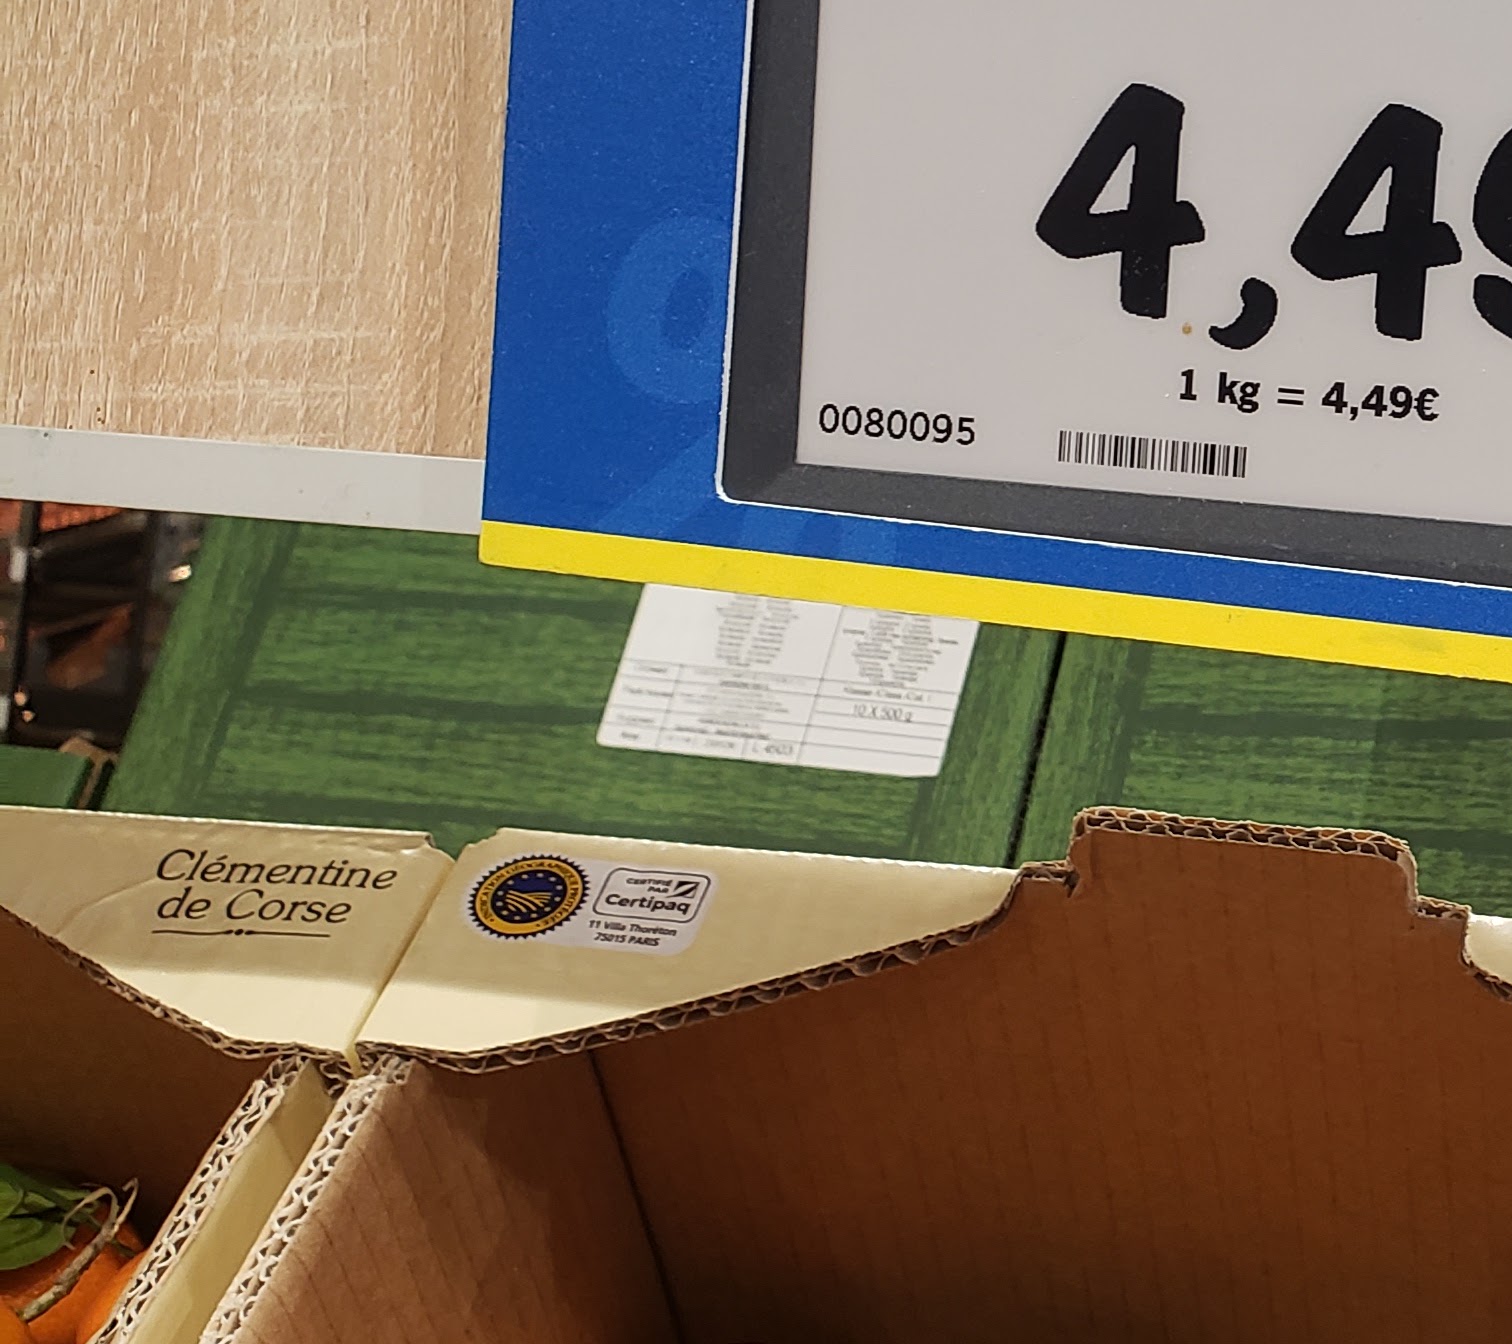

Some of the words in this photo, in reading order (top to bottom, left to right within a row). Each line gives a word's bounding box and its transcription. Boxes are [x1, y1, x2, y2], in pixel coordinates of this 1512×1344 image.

[1178, 368, 1198, 401] 1
[1217, 372, 1260, 413] kg
[1277, 385, 1305, 408] =
[1321, 381, 1441, 422] 4,49€
[818, 402, 977, 446] 0080095
[156, 849, 398, 890] Clémentine
[156, 886, 212, 920] de
[225, 889, 352, 923] Corse
[604, 893, 692, 916] Certipaq
